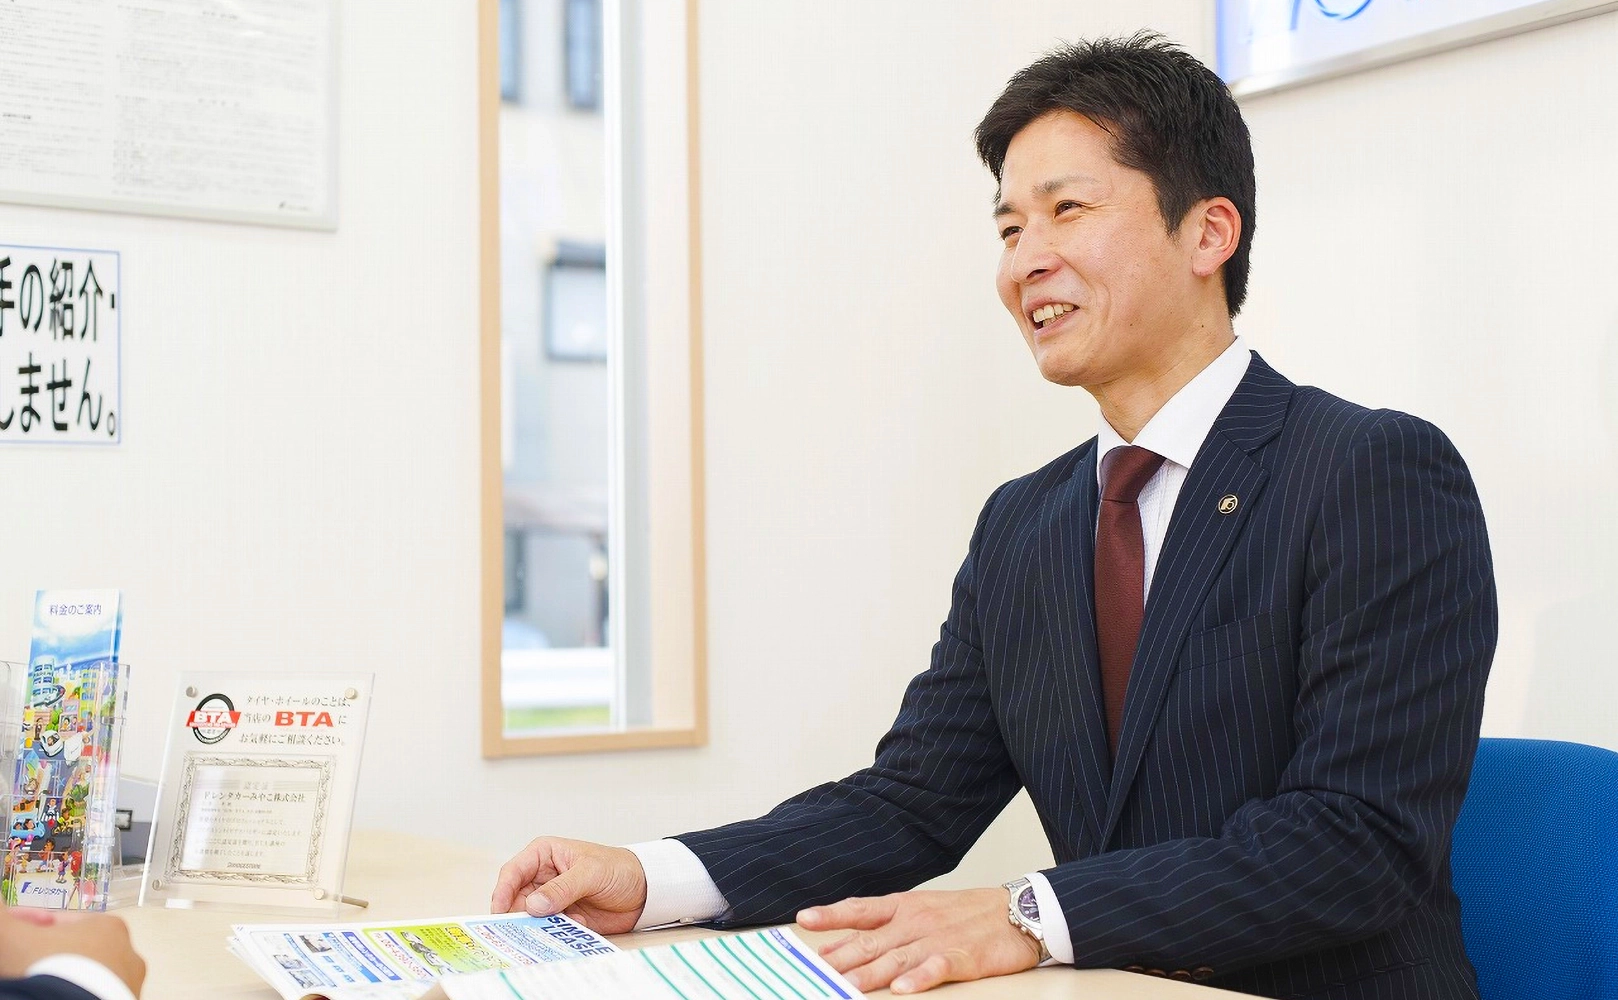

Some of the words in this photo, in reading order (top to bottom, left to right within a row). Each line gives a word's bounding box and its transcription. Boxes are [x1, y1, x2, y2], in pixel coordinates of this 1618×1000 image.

[50, 603, 102, 616] 料金のご案内
[193, 710, 233, 723] BTA
[243, 712, 271, 725] 当店の
[274, 711, 335, 727] BTA
[338, 714, 348, 725] に
[239, 732, 345, 746] お気軽にご相談ください。
[540, 924, 600, 957] LEASE
[547, 914, 616, 953] SIMPLE
